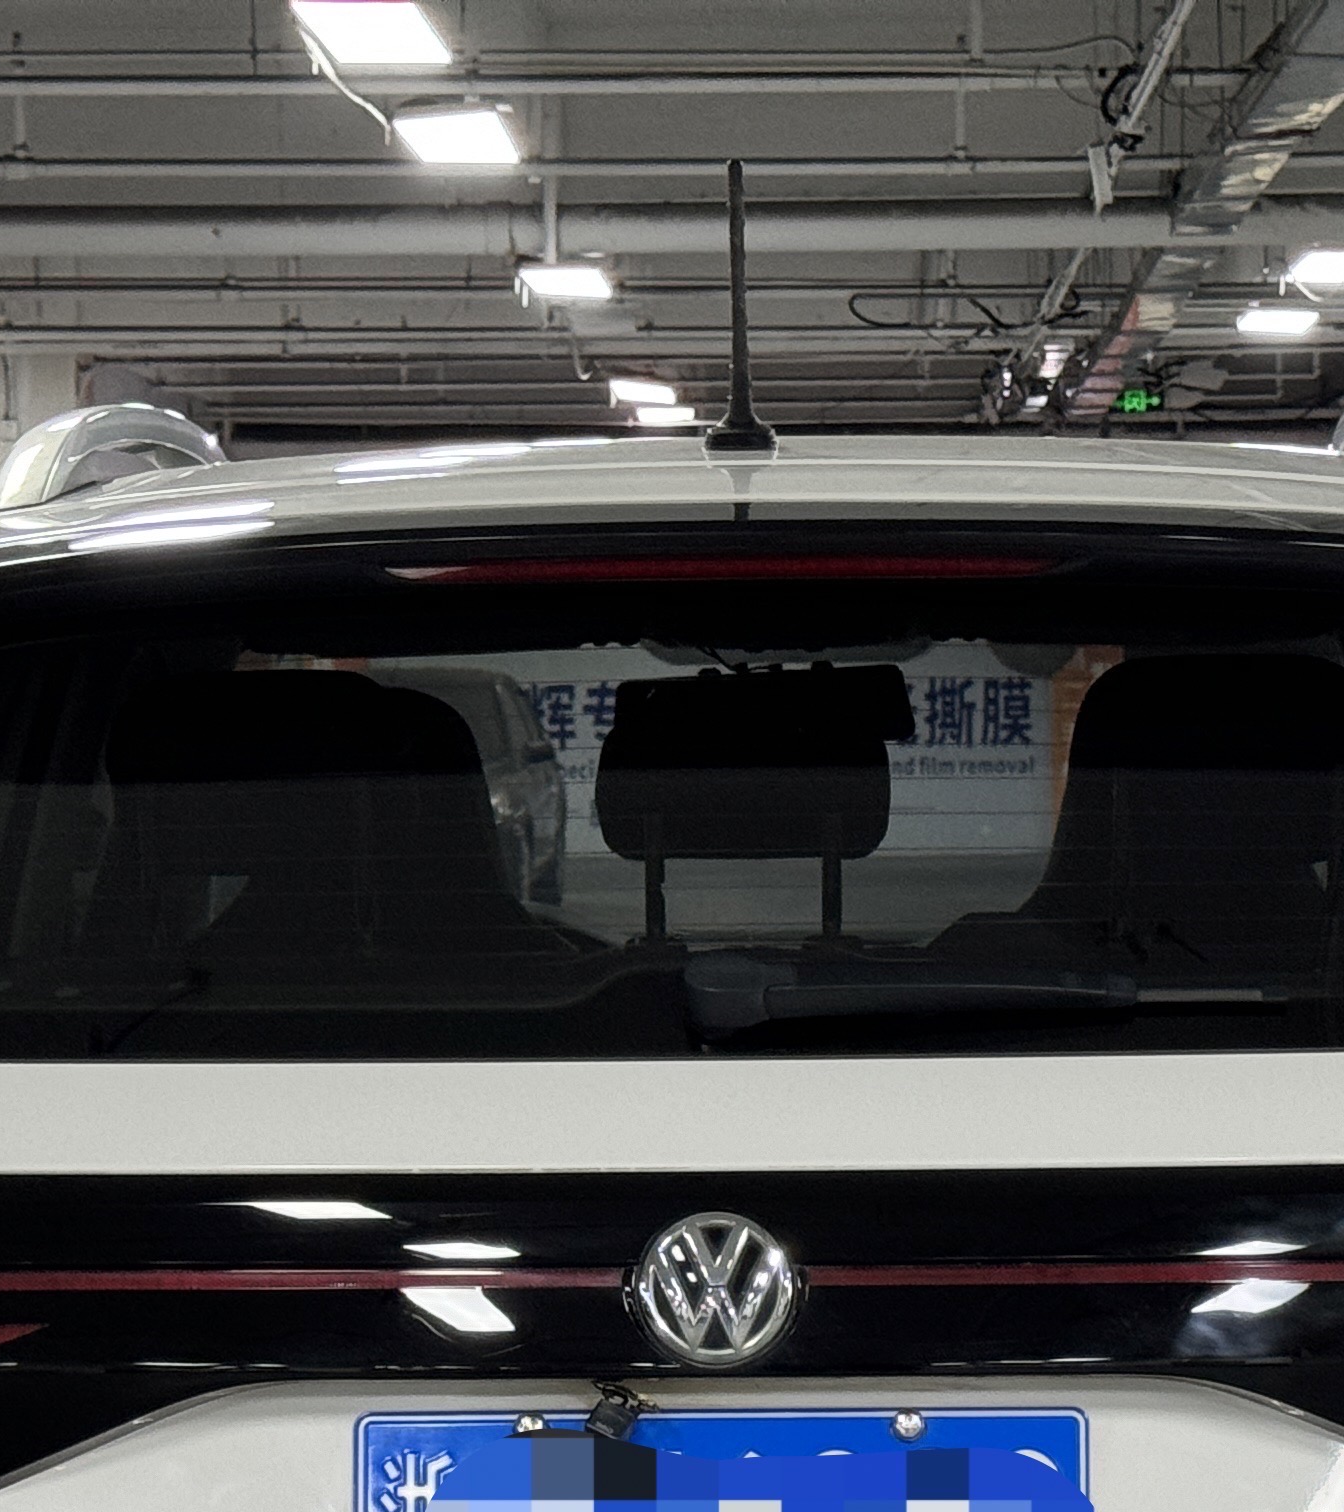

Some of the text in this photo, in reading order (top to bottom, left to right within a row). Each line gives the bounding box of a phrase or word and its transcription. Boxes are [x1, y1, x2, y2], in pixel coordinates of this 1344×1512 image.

[906, 677, 1033, 747] 撕膜
[920, 755, 956, 775] film
[960, 754, 1035, 776] removal
